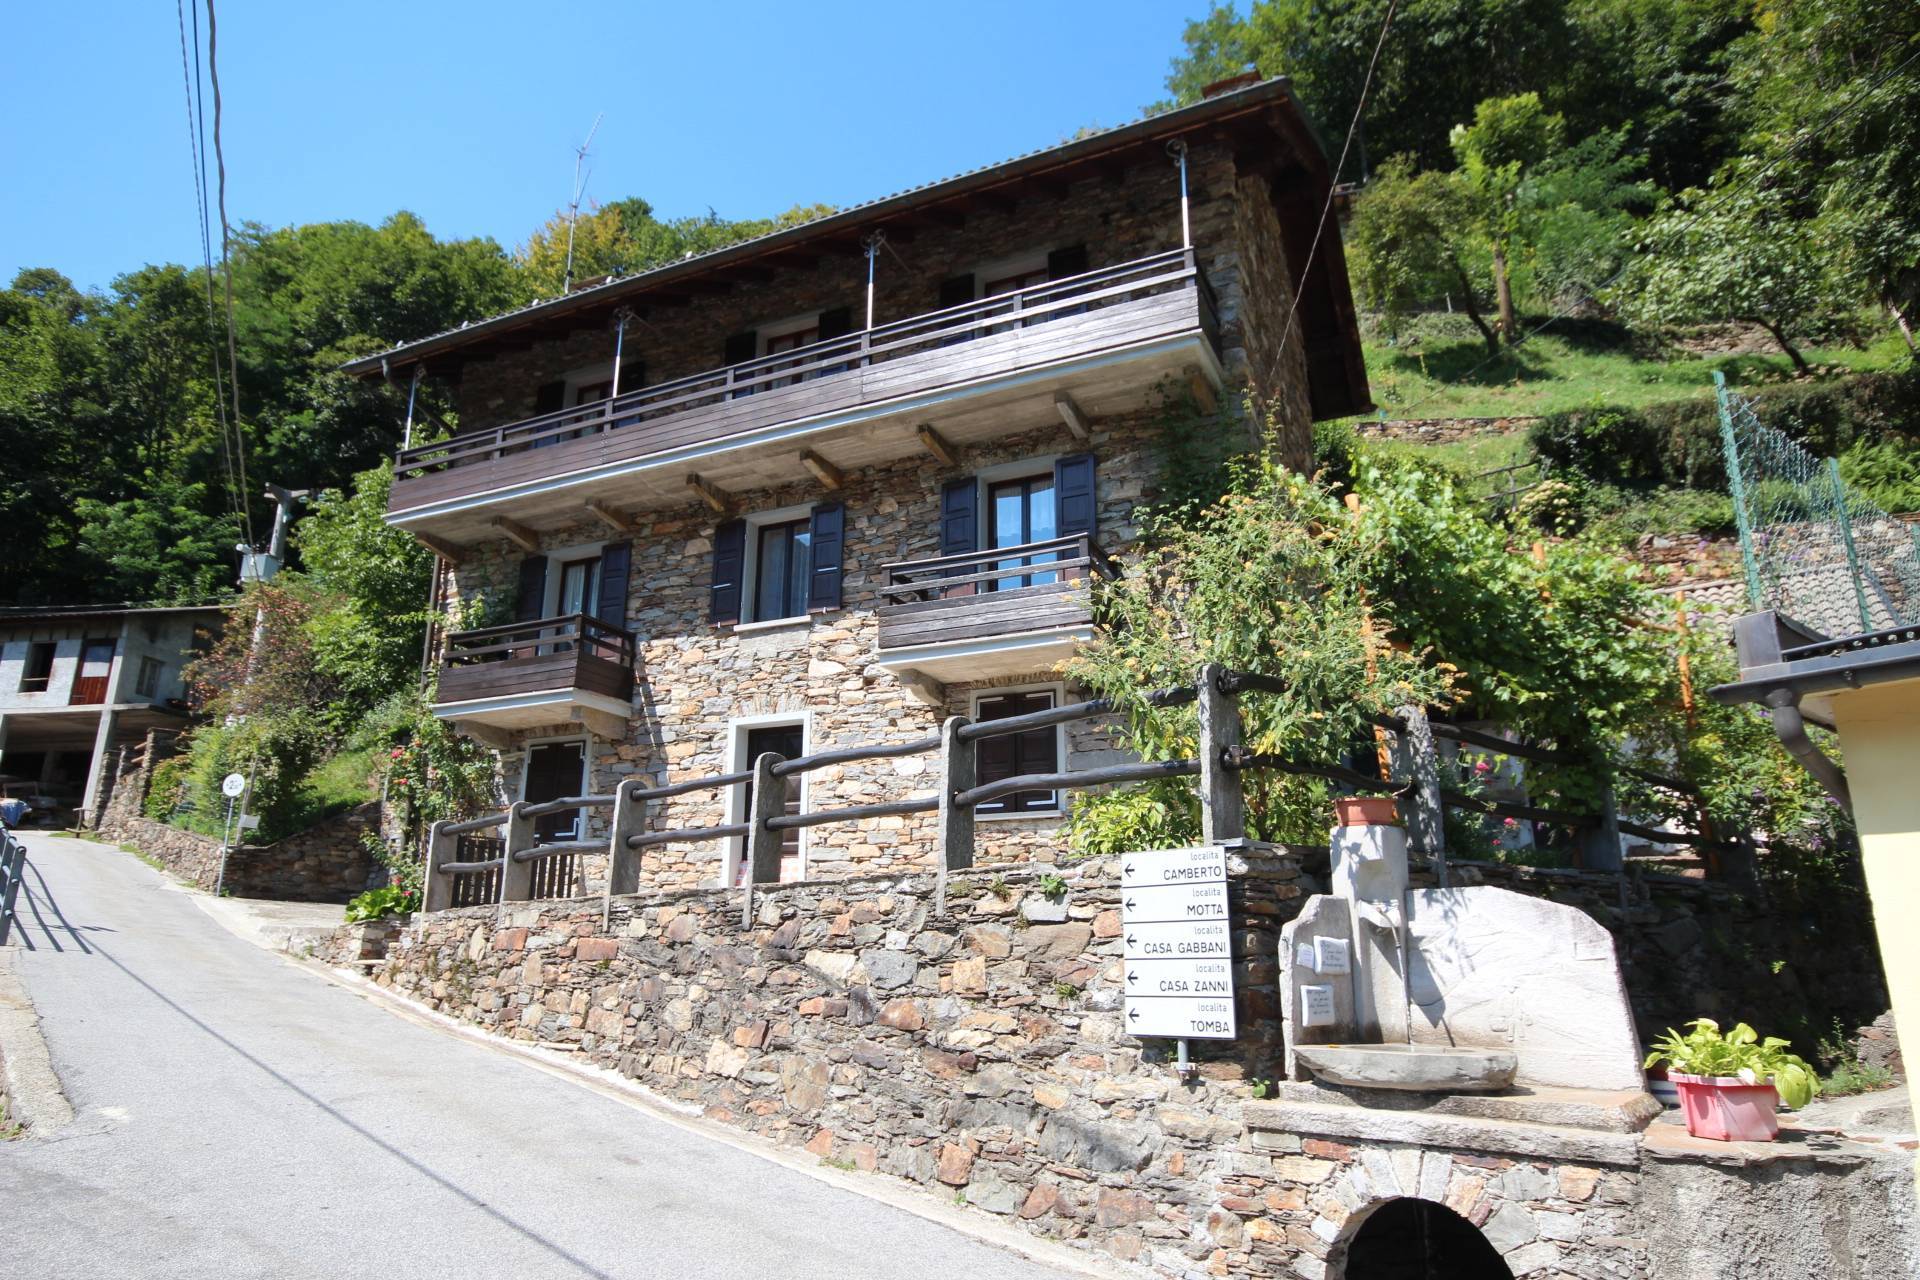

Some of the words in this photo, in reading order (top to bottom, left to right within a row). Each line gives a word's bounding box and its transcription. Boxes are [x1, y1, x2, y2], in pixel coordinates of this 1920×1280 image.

[1163, 865, 1222, 881] CAMBERTO
[1187, 903, 1224, 916] MOTTA
[1144, 942, 1173, 954] CASA
[1178, 941, 1227, 954] GABBANI
[1159, 979, 1189, 992] CASA
[1194, 980, 1229, 993] ZANNI
[1190, 1020, 1230, 1033] TOMBA
